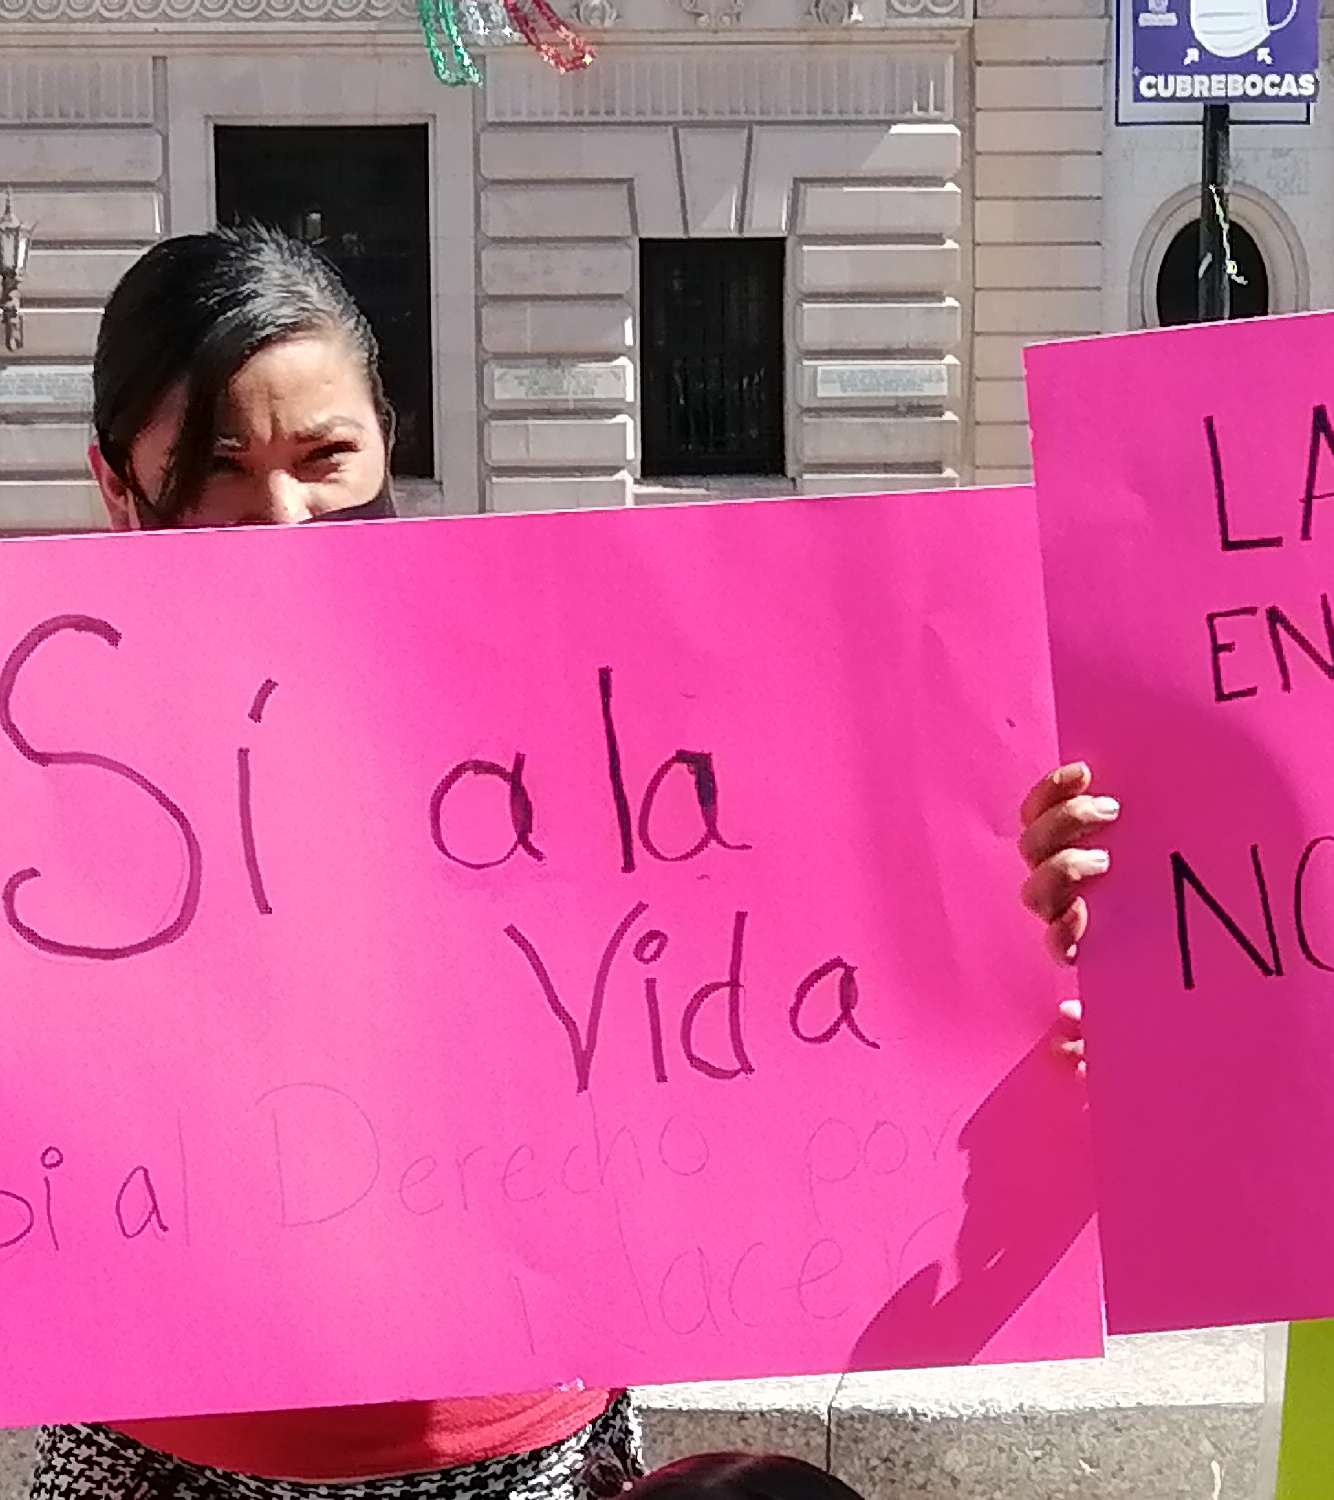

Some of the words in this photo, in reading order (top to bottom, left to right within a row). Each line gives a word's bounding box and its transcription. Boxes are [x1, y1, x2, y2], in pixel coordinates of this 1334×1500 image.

[1138, 73, 1315, 98] CUBREBOCAS
[429, 750, 547, 871] a
[598, 665, 754, 875] la
[504, 900, 882, 1095] Vida
[115, 1115, 192, 1248] al
[255, 1082, 710, 1228] Derecho
[805, 1098, 965, 1226] por
[507, 1198, 957, 1355] Nacer
